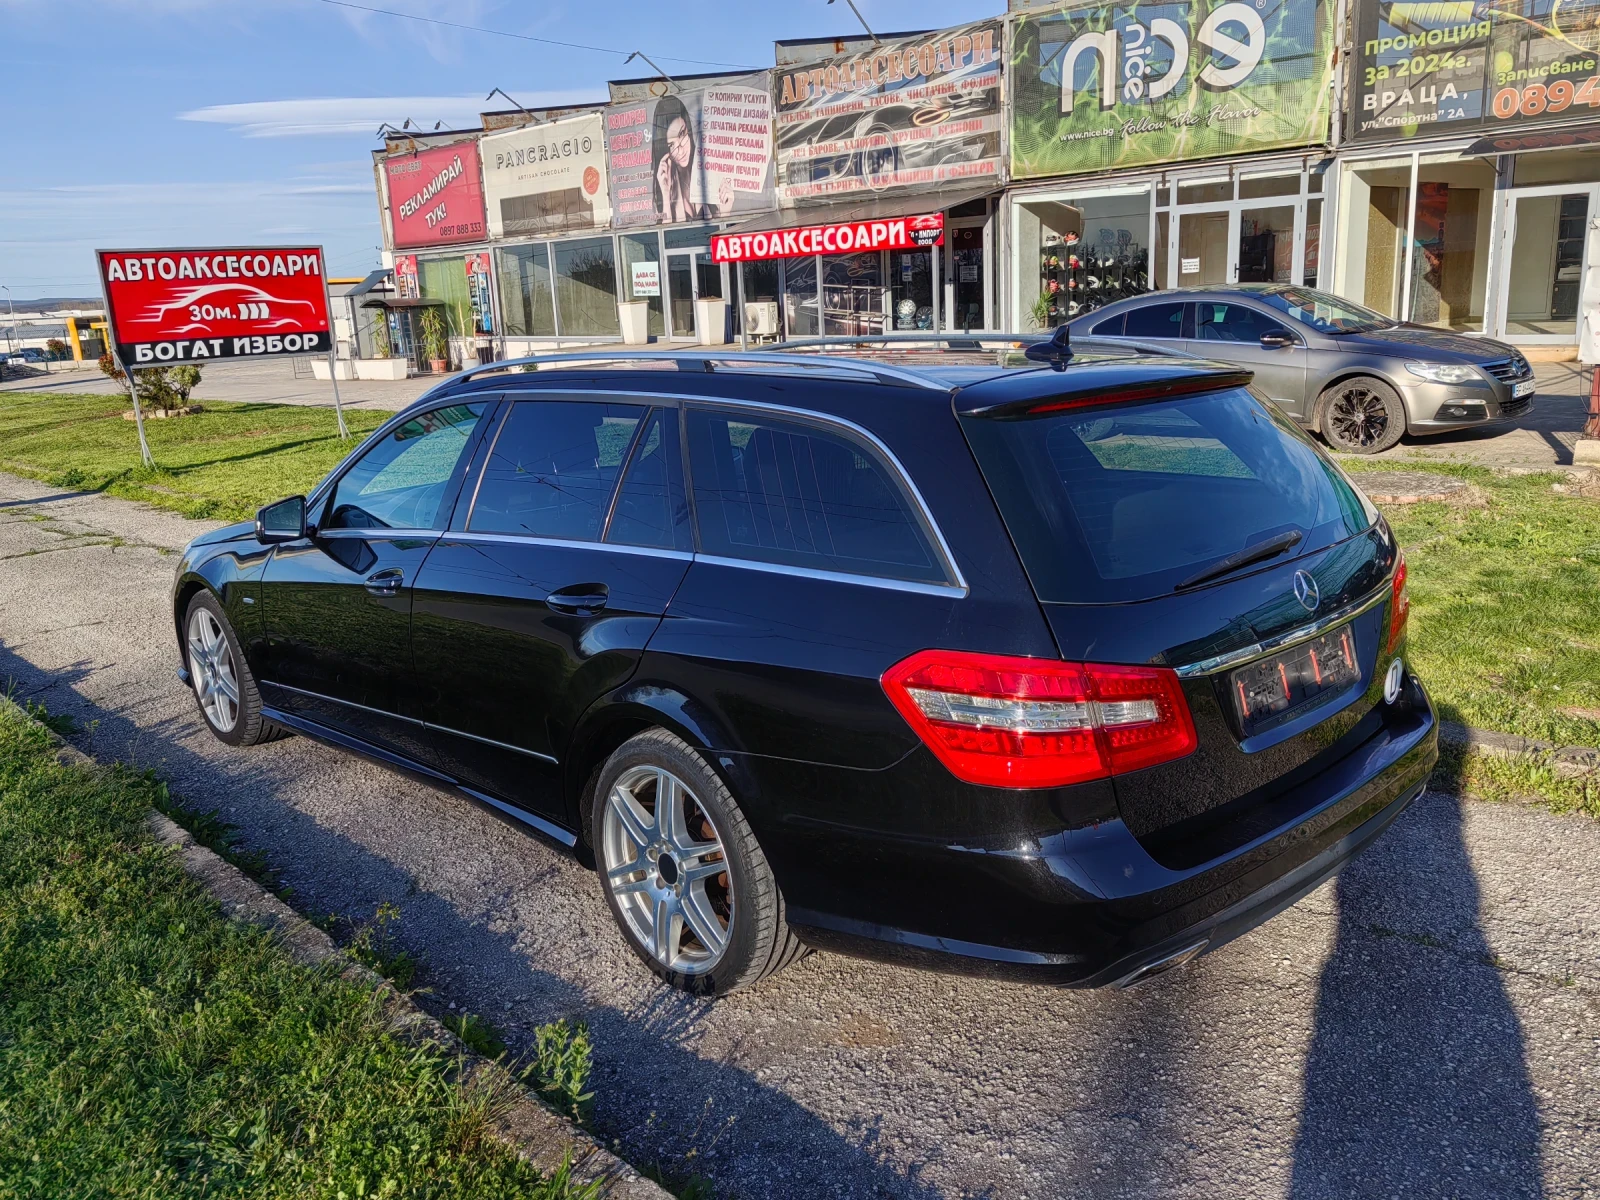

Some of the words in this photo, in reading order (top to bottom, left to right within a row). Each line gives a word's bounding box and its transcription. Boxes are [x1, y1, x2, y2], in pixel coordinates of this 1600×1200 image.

[1364, 20, 1491, 56] ПРОМОЦИЯ
[780, 29, 994, 105] АВТОАКСЕСОАРИ
[1395, 51, 1472, 78] 2024г.
[714, 92, 743, 103] КОПИРНИ
[743, 94, 768, 105] УСЛУГИ
[869, 93, 904, 107] ТАСОВЕ,
[906, 82, 958, 100] ЧИСТАЧКИ,
[1363, 82, 1468, 111] ВРАЦА,
[1492, 75, 1600, 119] 0894
[608, 108, 647, 130] КОПИРЕН
[710, 106, 742, 118] ГРАФИЧЕН
[742, 108, 769, 120] ДИЗАЙН
[1059, 127, 1114, 142] www.nice.bg
[1119, 116, 1167, 139] Follow
[1171, 109, 1200, 128] the
[1205, 102, 1263, 126] Flavor
[609, 130, 644, 152] ЦЕНТЪР
[643, 128, 652, 143] &
[709, 120, 737, 132] ПЕЧАТНА
[737, 122, 768, 135] РЕКЛАМА
[495, 136, 592, 169] PANCRACIO
[708, 134, 734, 146] ВЪНШНА
[734, 137, 764, 149] РЕКЛАМА
[808, 143, 840, 156] БАРОВЕ,
[892, 127, 934, 142] КРУШКИ,
[611, 148, 653, 169] РЕКЛАМА
[703, 147, 734, 160] РЕКЛАМНИ
[735, 151, 767, 164] СУВЕНИРИ
[517, 172, 539, 180] ARTISAN
[540, 167, 570, 177] CHOCOLATE
[704, 161, 735, 174] ФИРМЕНИ
[735, 165, 760, 177] ПЕЧАТИ
[399, 154, 463, 221] РЕКЛАМИРАЙ
[733, 178, 760, 191] ТЕНИСКИ
[424, 202, 447, 229] ТУК!
[439, 225, 455, 236] 0897
[456, 224, 469, 235] 888
[470, 222, 482, 233] 333
[715, 220, 906, 260] АВТОАКСЕСОАРИ
[107, 254, 320, 282] АВТОАКСЕСОАРИ
[189, 303, 238, 322] 30м.
[134, 338, 224, 362] БОГАТ
[233, 333, 320, 355] ИЗБОР
